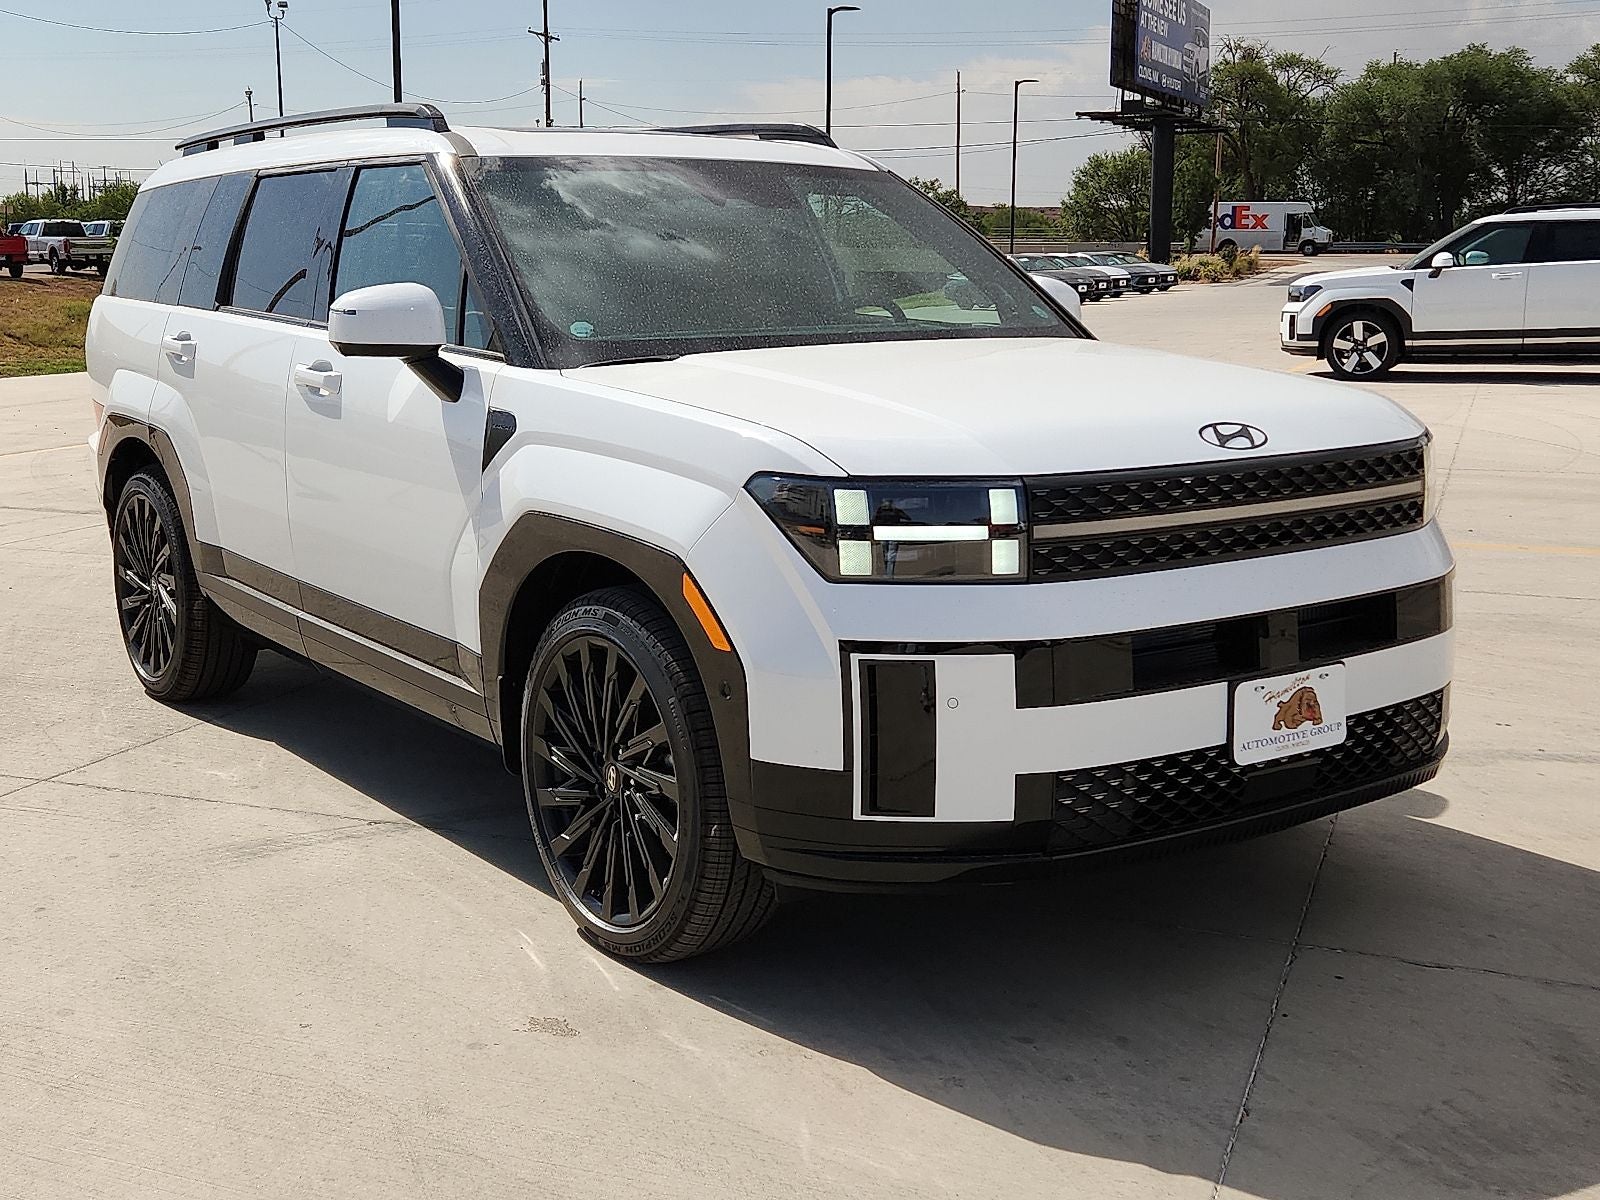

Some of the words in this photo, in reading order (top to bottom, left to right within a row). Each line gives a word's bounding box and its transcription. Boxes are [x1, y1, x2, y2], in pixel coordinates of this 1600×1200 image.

[1140, 10, 1148, 28] AT
[1148, 13, 1157, 33] THE
[1157, 18, 1169, 38] NEW
[1177, 0, 1186, 26] US
[1240, 729, 1308, 752] AUTOMOTIVE
[1310, 721, 1342, 737] GROUP
